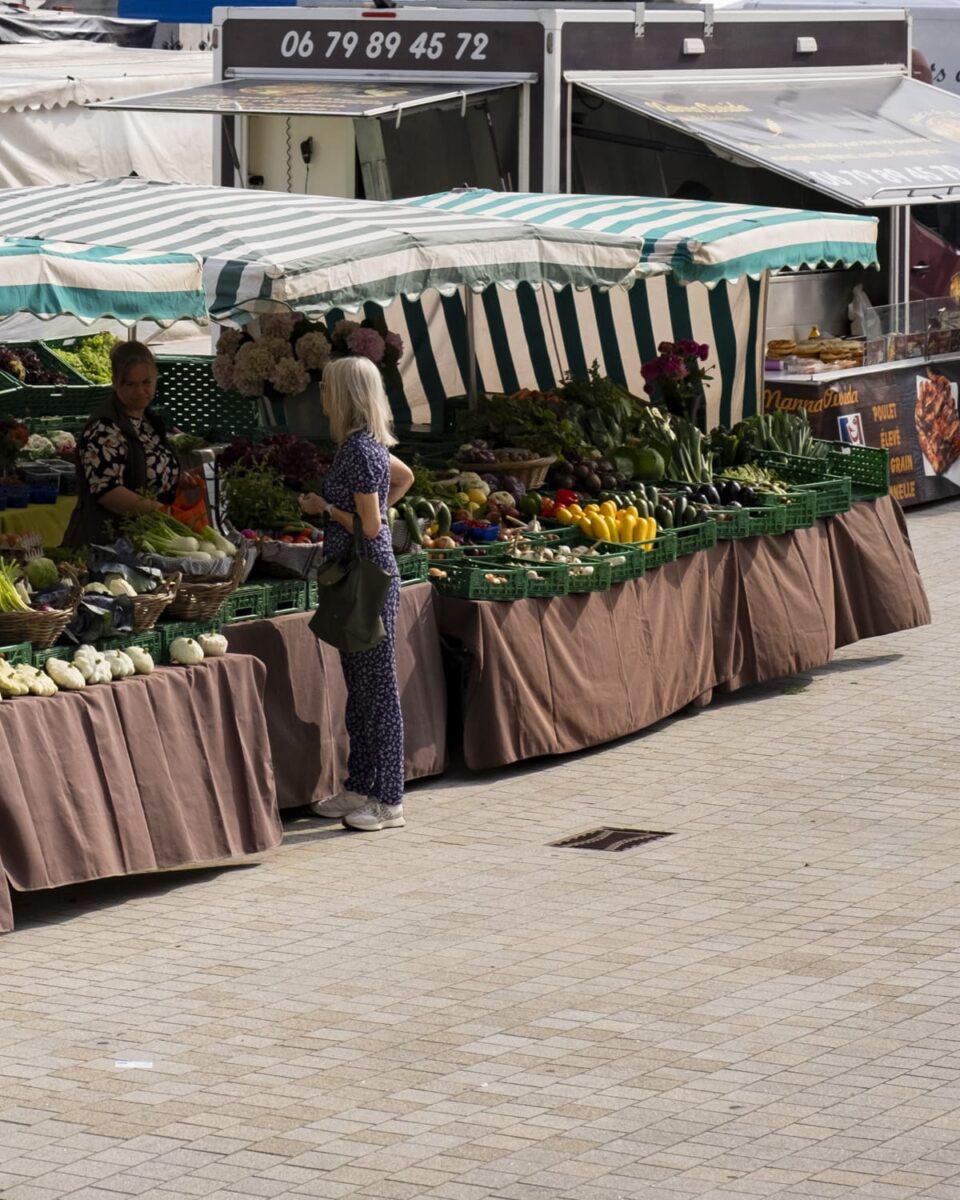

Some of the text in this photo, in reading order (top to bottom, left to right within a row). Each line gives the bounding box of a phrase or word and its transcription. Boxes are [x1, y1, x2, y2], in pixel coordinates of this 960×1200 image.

[280, 30, 489, 60] 06 79 89 45 72
[872, 403, 897, 422] POULET
[890, 454, 914, 474] GRAIN
